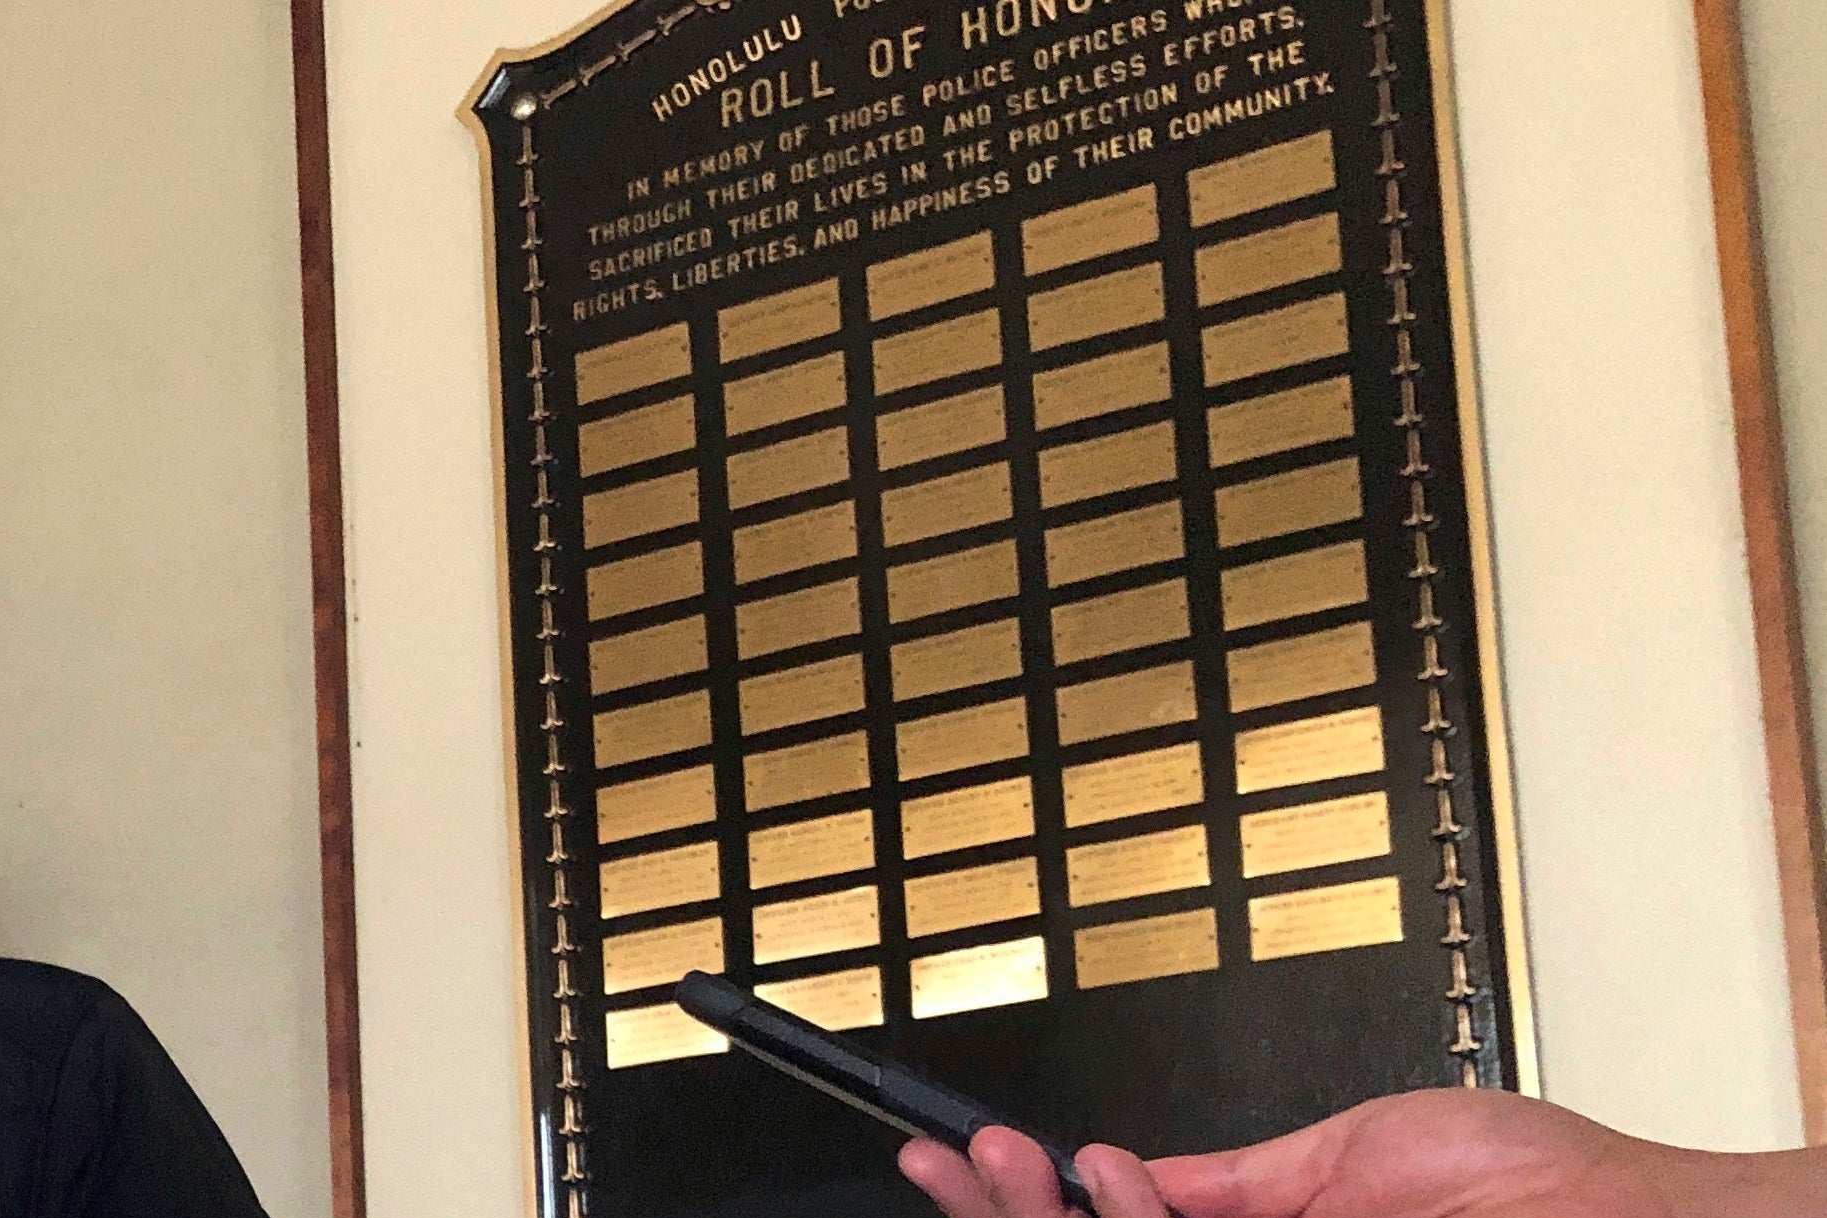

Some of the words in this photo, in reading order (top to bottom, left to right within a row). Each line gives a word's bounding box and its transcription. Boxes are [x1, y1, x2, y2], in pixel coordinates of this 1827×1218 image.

[627, 176, 650, 200] IN
[663, 139, 765, 187] MEMORY
[778, 125, 808, 153] OF
[826, 94, 906, 136] THOSE
[923, 60, 1015, 107] POLICE
[1034, 10, 1168, 71] OFFICERS
[651, 14, 802, 122] HONOLULU
[721, 59, 835, 128] ROLL
[869, 26, 924, 78] OF
[961, 0, 1111, 49] HON
[588, 199, 691, 246] THROUGH
[707, 173, 775, 209] THEIR
[789, 125, 926, 184] DEDICATED
[942, 104, 992, 135] AND
[1005, 54, 1147, 118] SELFLESS
[588, 227, 713, 281] SACRIFICED
[727, 199, 800, 239] THEIR
[813, 172, 888, 213] LIVES
[900, 162, 928, 186] IN
[944, 139, 992, 173] THE
[1007, 83, 1178, 153] PROTECTION
[1194, 65, 1229, 95] OF
[1247, 40, 1306, 78] THE
[812, 217, 859, 251] AND
[872, 172, 1011, 231] HAPPINESS
[1026, 155, 1059, 186] OF
[1073, 127, 1155, 170] THEIR
